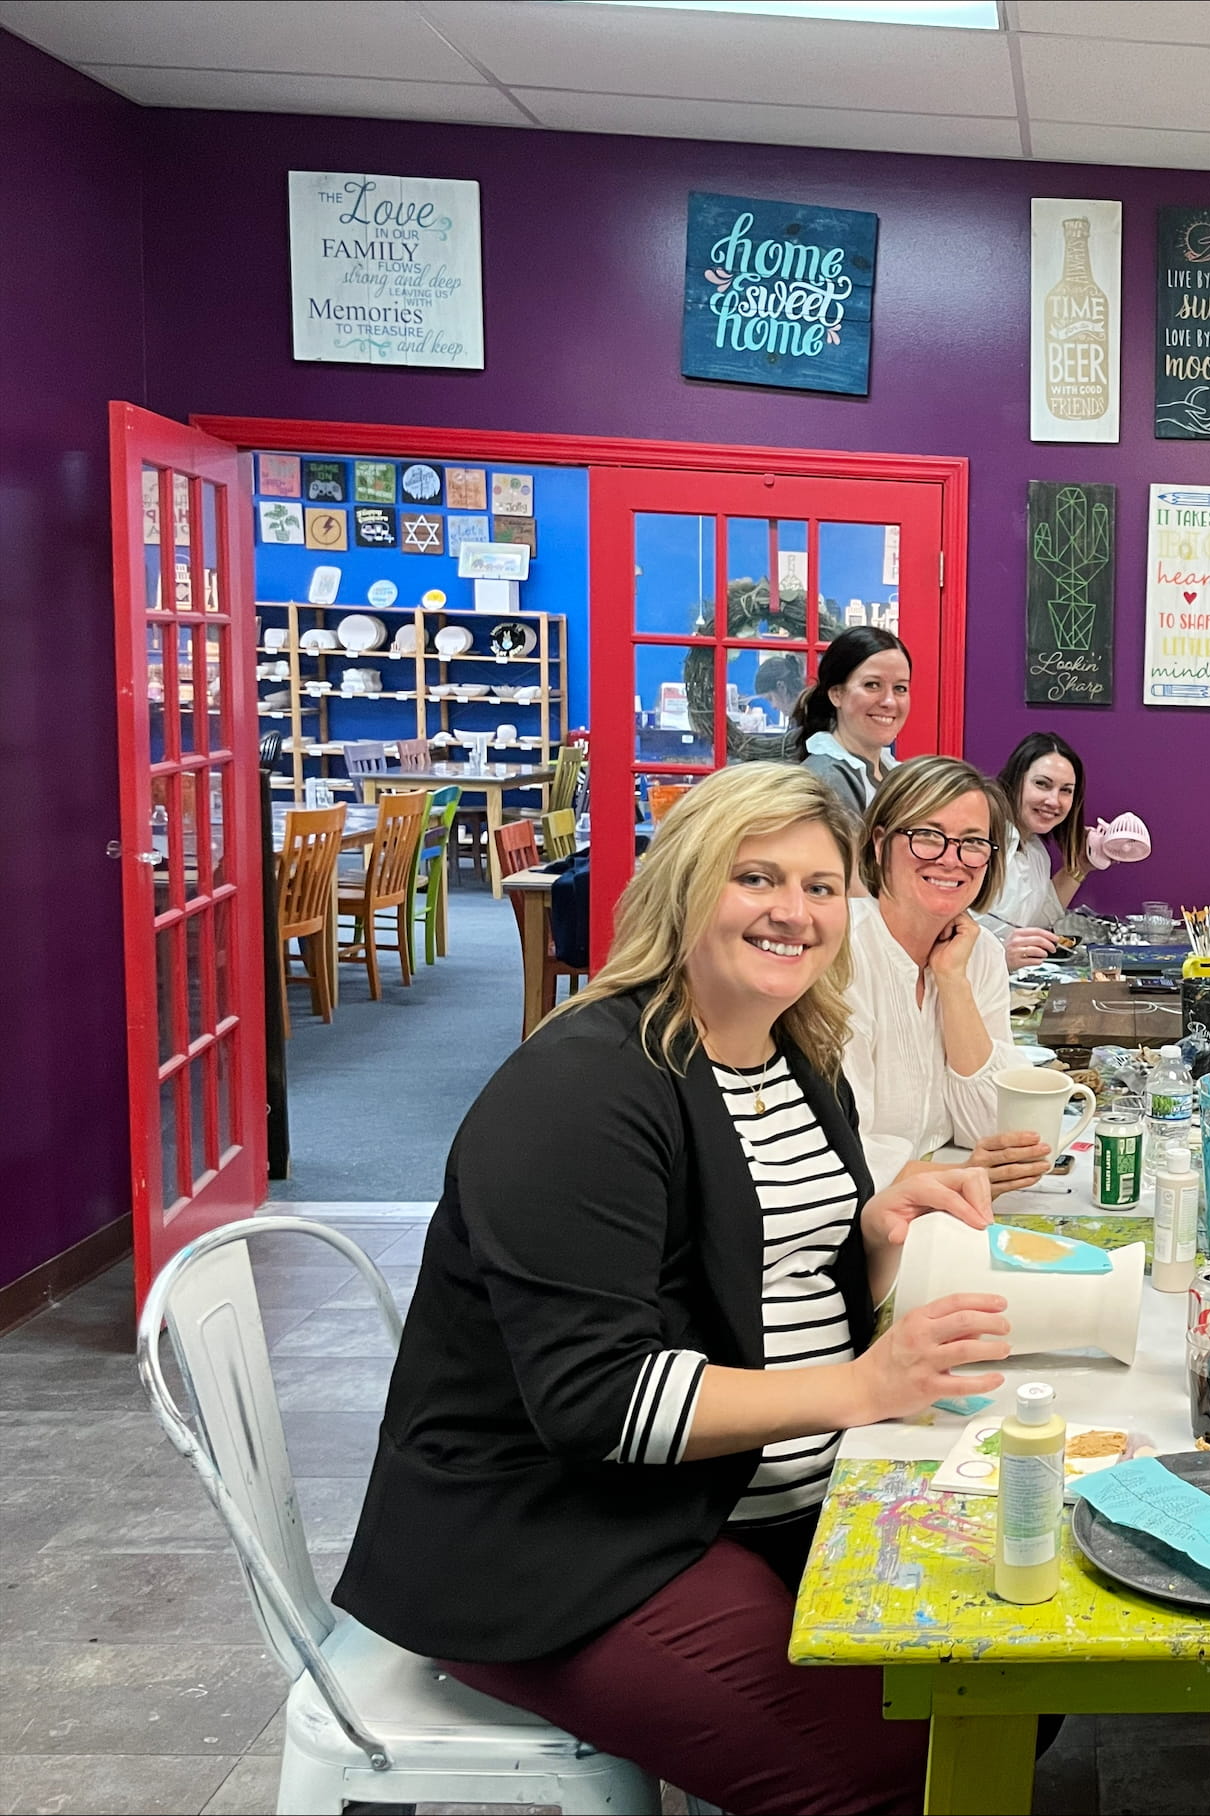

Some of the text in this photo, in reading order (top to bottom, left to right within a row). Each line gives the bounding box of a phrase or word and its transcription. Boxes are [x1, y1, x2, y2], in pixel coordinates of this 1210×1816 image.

[318, 181, 438, 228] THE Love
[375, 228, 420, 240] IN OUR
[321, 238, 419, 262] FAMILY
[710, 212, 845, 286] home
[378, 261, 422, 274] FLOWS
[1167, 269, 1192, 289] LIVE
[1196, 270, 1210, 290] BY
[342, 264, 462, 297] strong and deep
[389, 288, 448, 299] LEAVING US
[406, 298, 433, 307] WITH
[738, 276, 853, 327] sweet
[308, 298, 423, 324] Memories
[1049, 296, 1105, 320] TIME
[336, 323, 424, 338] TO TREASURE
[710, 290, 825, 357] home
[397, 329, 433, 353] and
[1165, 328, 1191, 348] LOVE
[1196, 329, 1210, 348] BY
[1048, 342, 1107, 385] BEER
[1051, 385, 1103, 395] WITH GOOD
[1050, 397, 1105, 418] FRIENDS
[1157, 509, 1171, 526] IT
[1158, 612, 1176, 630] TO
[1029, 650, 1102, 674] Lookin'
[1048, 673, 1105, 701] Sharp
